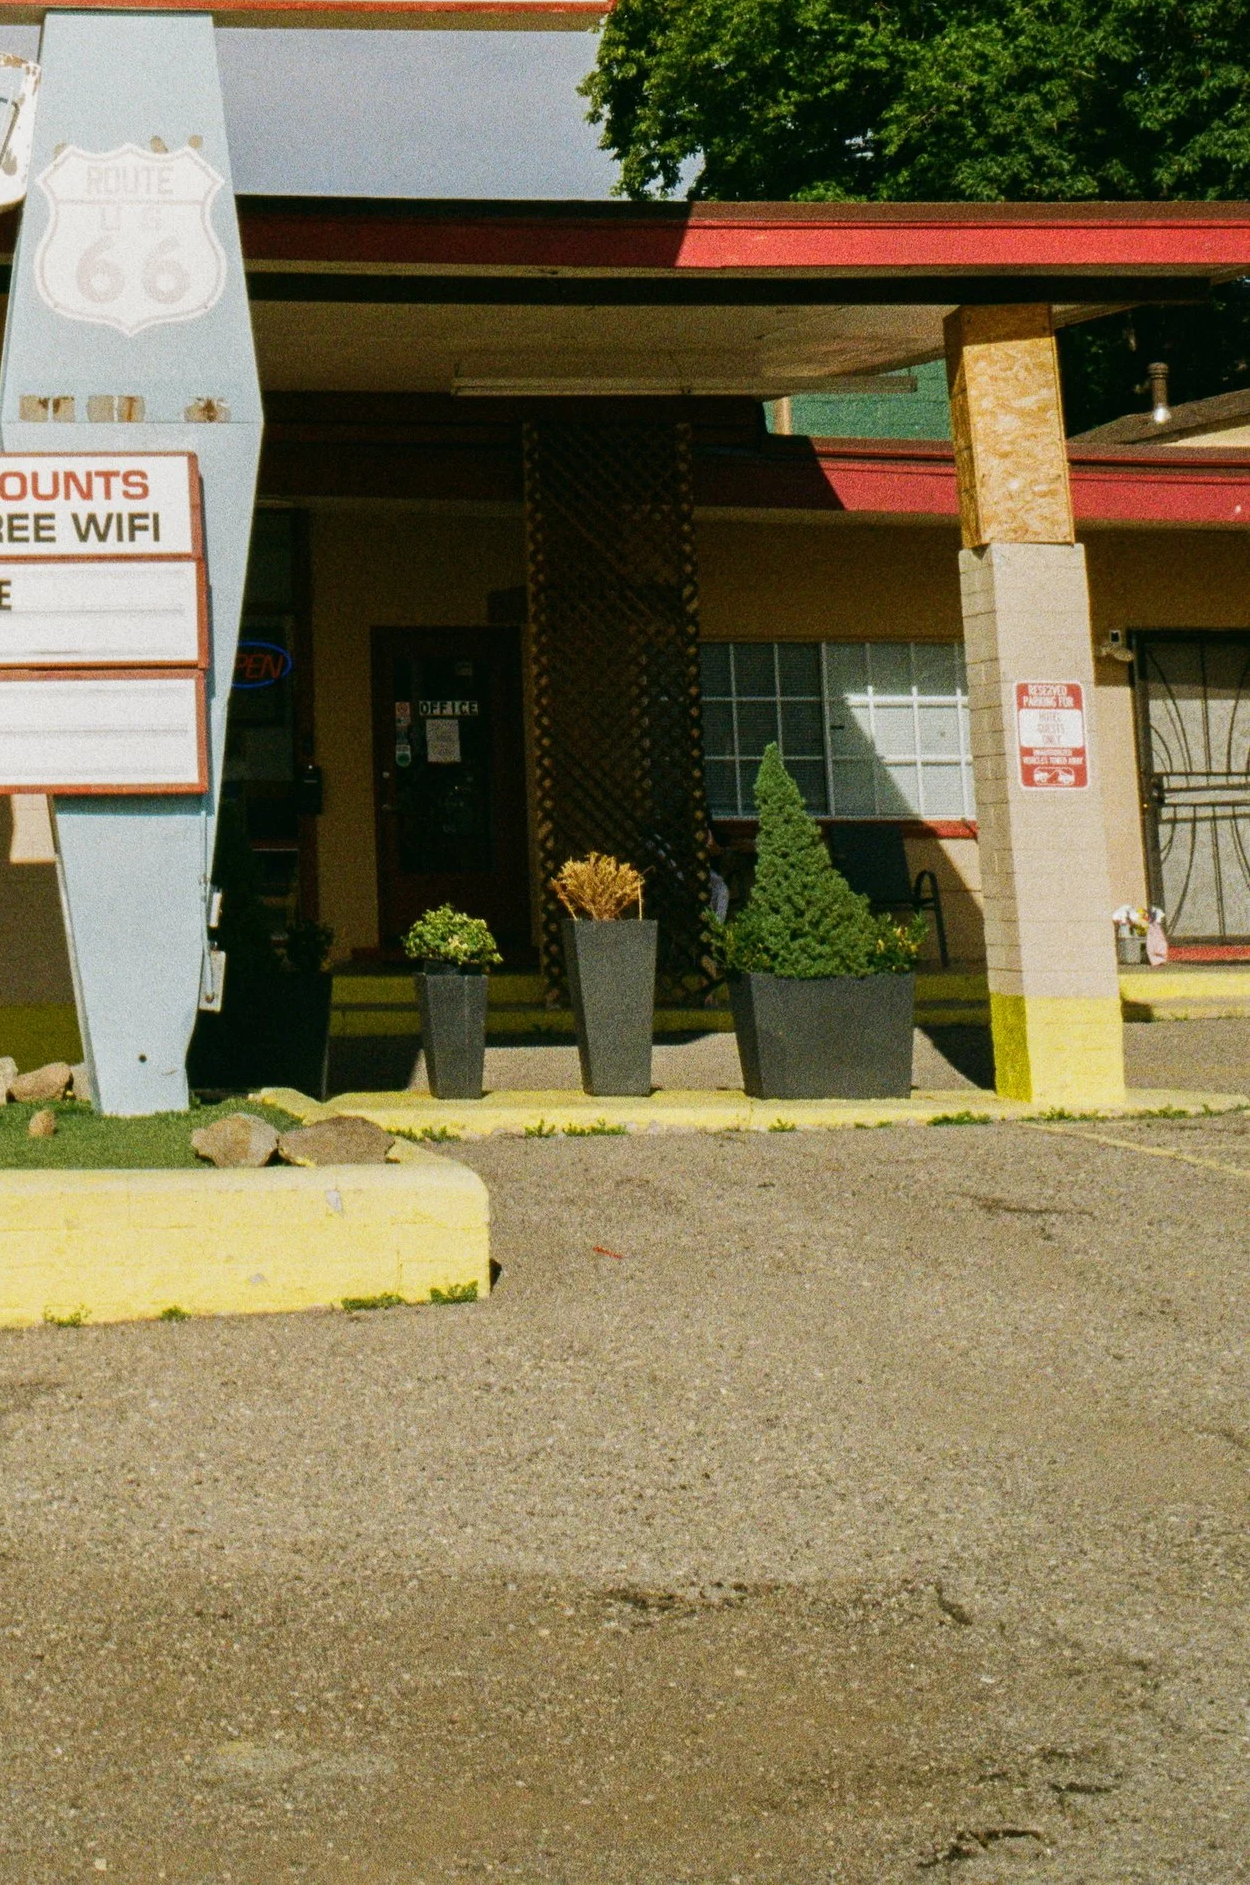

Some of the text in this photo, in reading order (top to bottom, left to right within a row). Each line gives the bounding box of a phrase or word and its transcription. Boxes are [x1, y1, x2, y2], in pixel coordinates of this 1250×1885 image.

[86, 165, 174, 195] ROUTE
[99, 206, 161, 231] US
[74, 235, 189, 304] 66
[71, 512, 161, 543] WIFI
[235, 653, 285, 679] PEN
[419, 701, 478, 715] OFFICE
